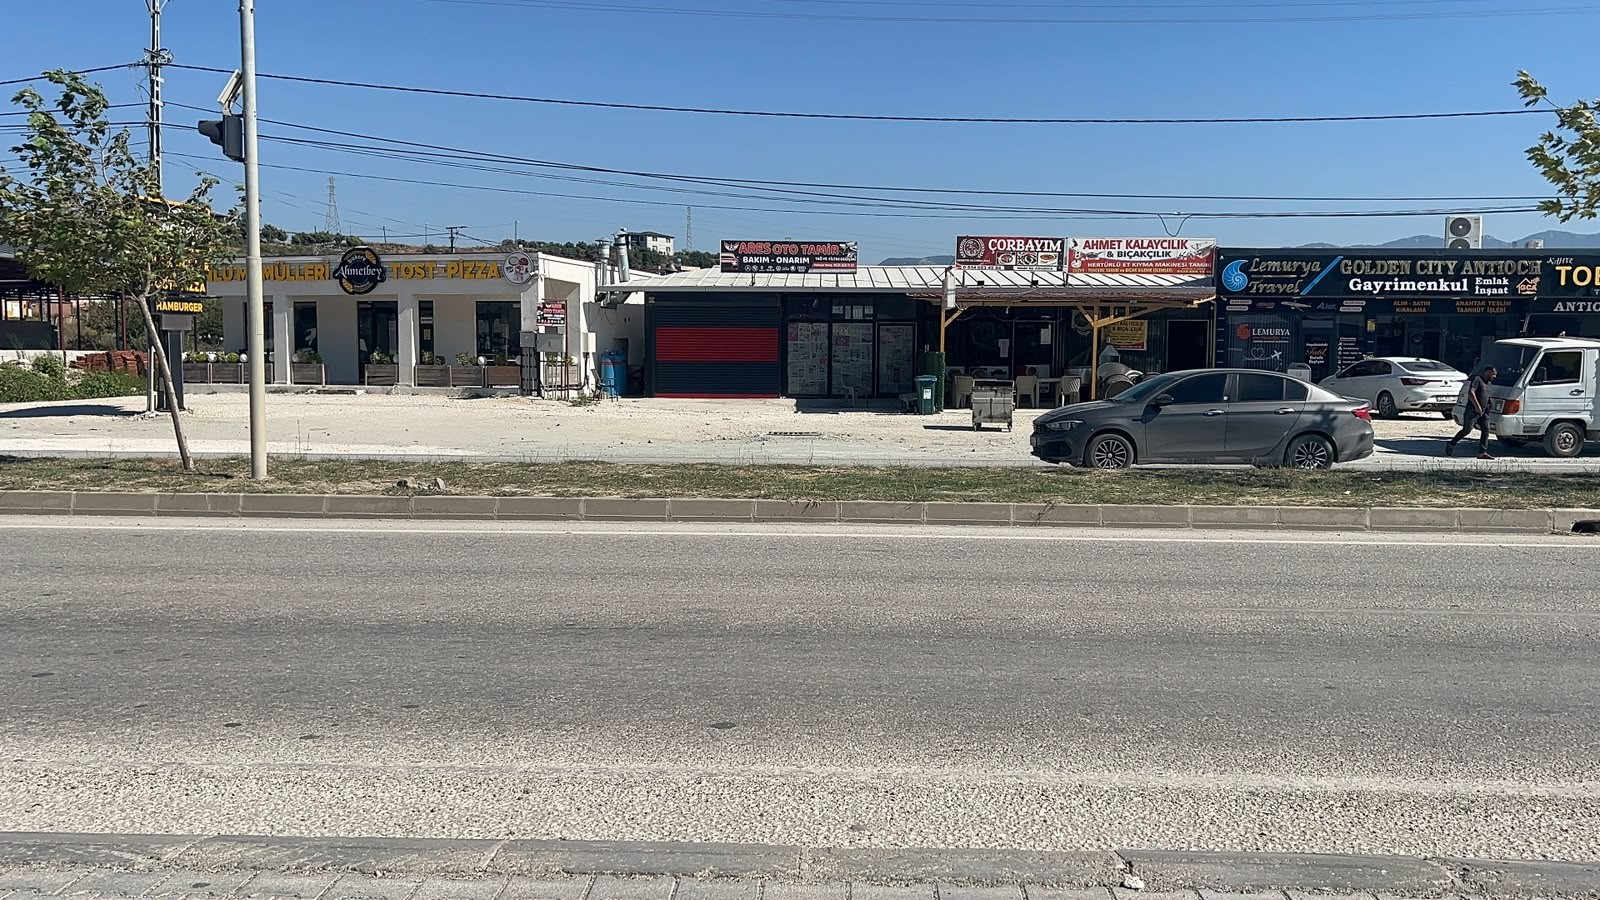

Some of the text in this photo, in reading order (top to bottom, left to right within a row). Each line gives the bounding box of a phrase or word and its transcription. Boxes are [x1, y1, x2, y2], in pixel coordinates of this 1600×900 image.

[738, 242, 839, 256] ARES OTO TAMİR
[988, 238, 1062, 254] ÇORBAYIM
[1083, 239, 1188, 250] AHMET KALAYCILIK
[742, 256, 770, 264] BAKIM
[777, 256, 810, 265] ONARIM
[1106, 250, 1171, 259] & BIÇAKÇILIK
[237, 260, 330, 281] MMÜLLERİ
[334, 264, 383, 280] Ahmetbey
[390, 261, 438, 280] TOST
[447, 258, 501, 280] PİZZA
[1248, 257, 1321, 278] Lemurya
[1340, 259, 1542, 275] GOLDEN CITY ANTIOCH
[1248, 279, 1304, 294] Travel
[1348, 277, 1468, 294] Gayrimenkul
[1475, 276, 1509, 285] Emlak
[1474, 285, 1509, 296] İnşaat
[156, 301, 203, 312] HAMBURGER
[1252, 328, 1291, 336] LEMURYA
